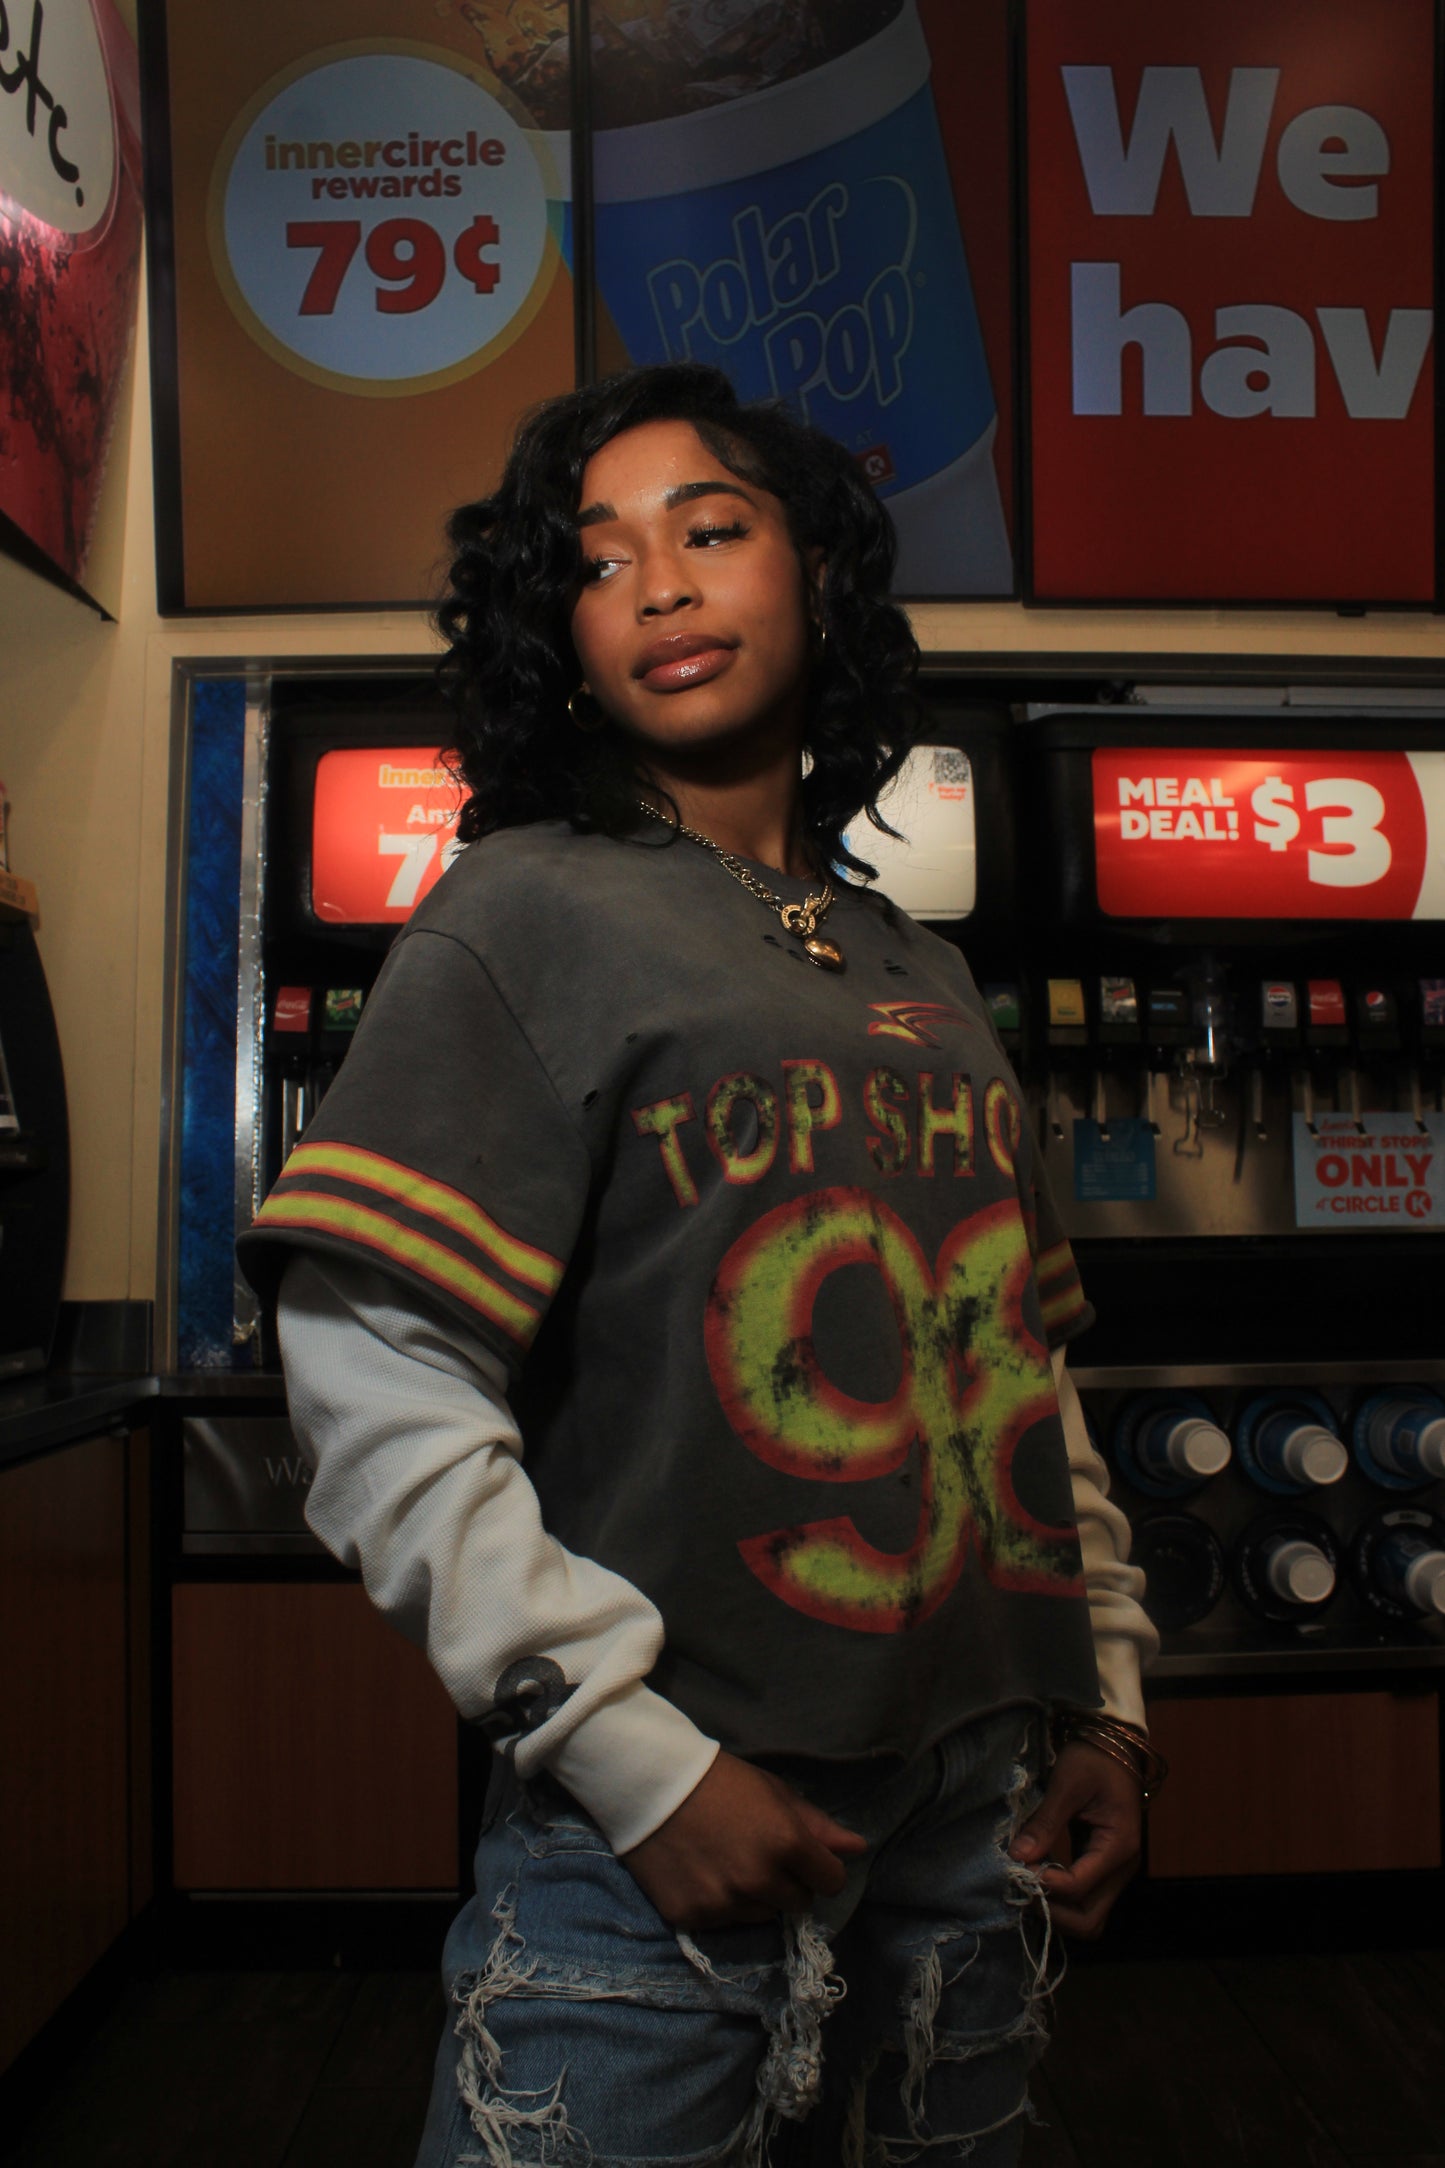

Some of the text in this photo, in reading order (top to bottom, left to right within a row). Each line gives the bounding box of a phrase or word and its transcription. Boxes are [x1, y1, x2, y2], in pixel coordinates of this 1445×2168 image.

[265, 131, 505, 170] innercircle
[312, 168, 462, 200] rewards
[1060, 65, 1391, 221] We
[286, 215, 501, 317] 79¢
[646, 182, 848, 363] Polar
[1070, 262, 1434, 419] hav
[1118, 776, 1393, 887] MEAL $3
[1119, 809, 1239, 841] DEAL!
[378, 833, 470, 909] 7
[631, 1059, 842, 1209] TOP
[1316, 1154, 1431, 1187] ONLY
[1330, 1196, 1400, 1213] CIRCLE
[1404, 1190, 1432, 1218] K
